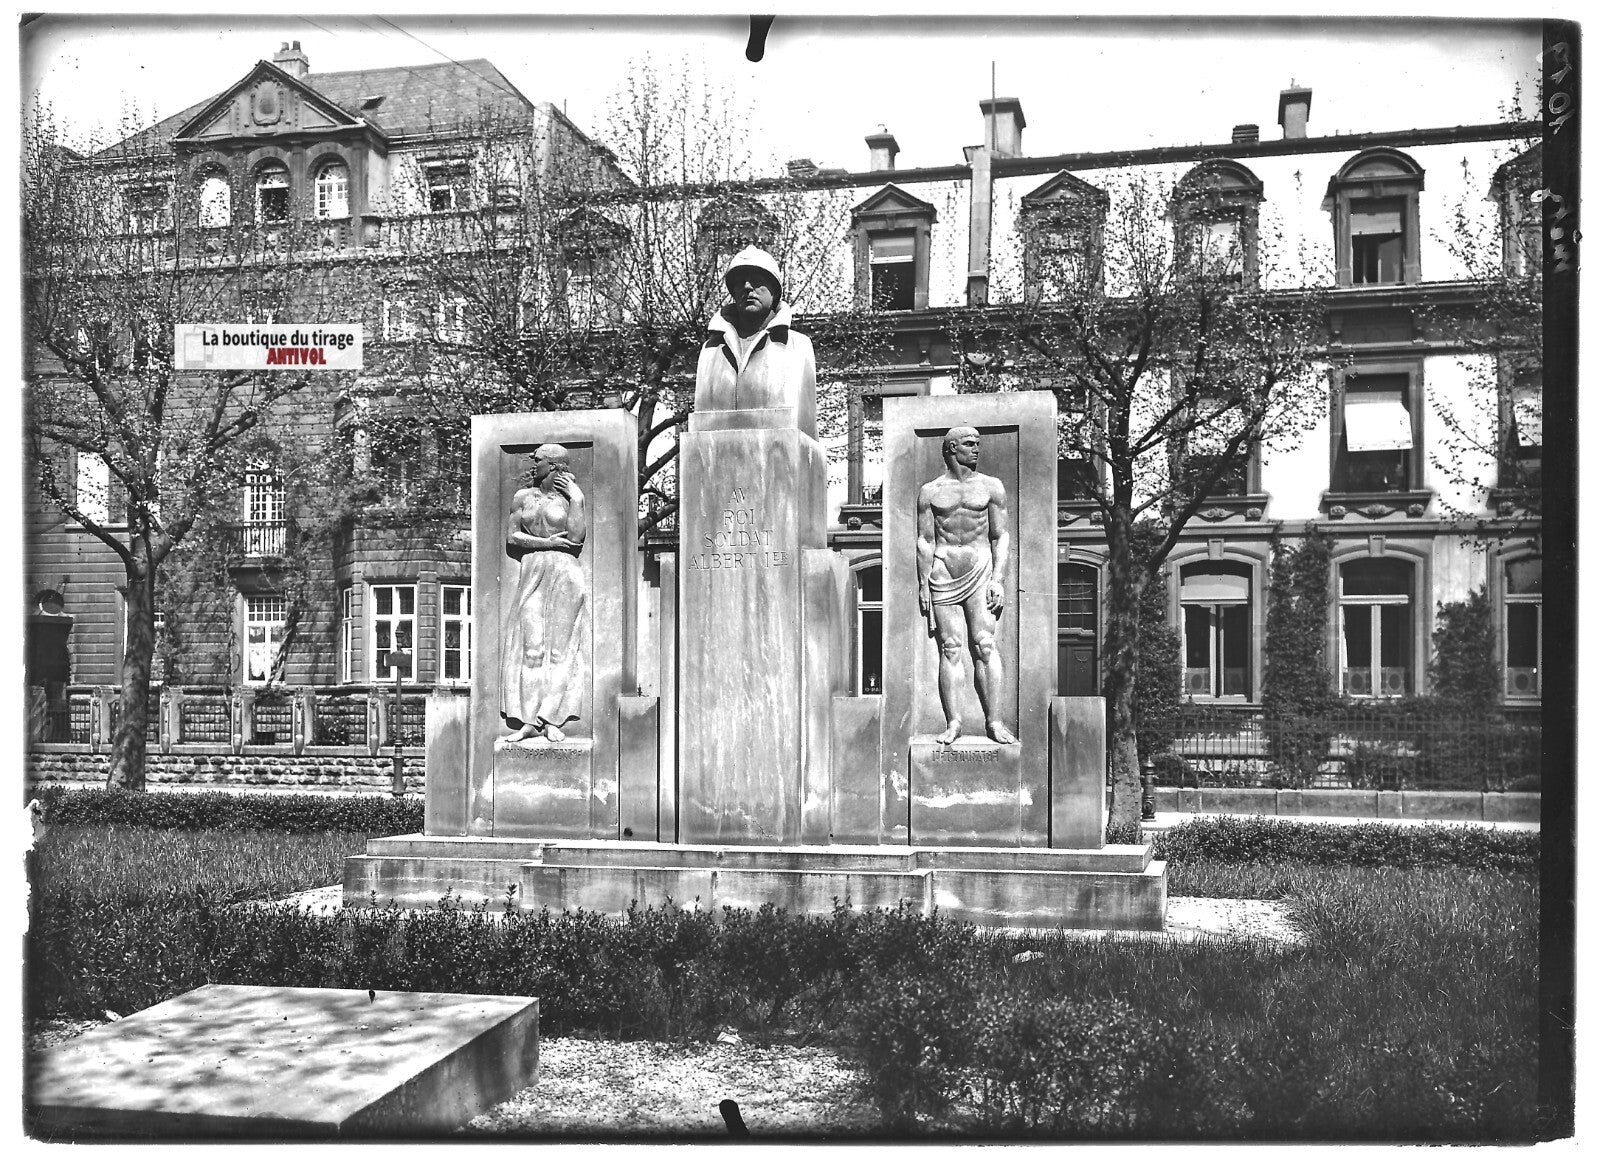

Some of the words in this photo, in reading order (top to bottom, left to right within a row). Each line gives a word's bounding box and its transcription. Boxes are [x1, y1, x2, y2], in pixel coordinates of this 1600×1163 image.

[723, 508, 754, 525] ROI
[704, 529, 773, 547] SOLDAT
[688, 552, 757, 569] ALBERT
